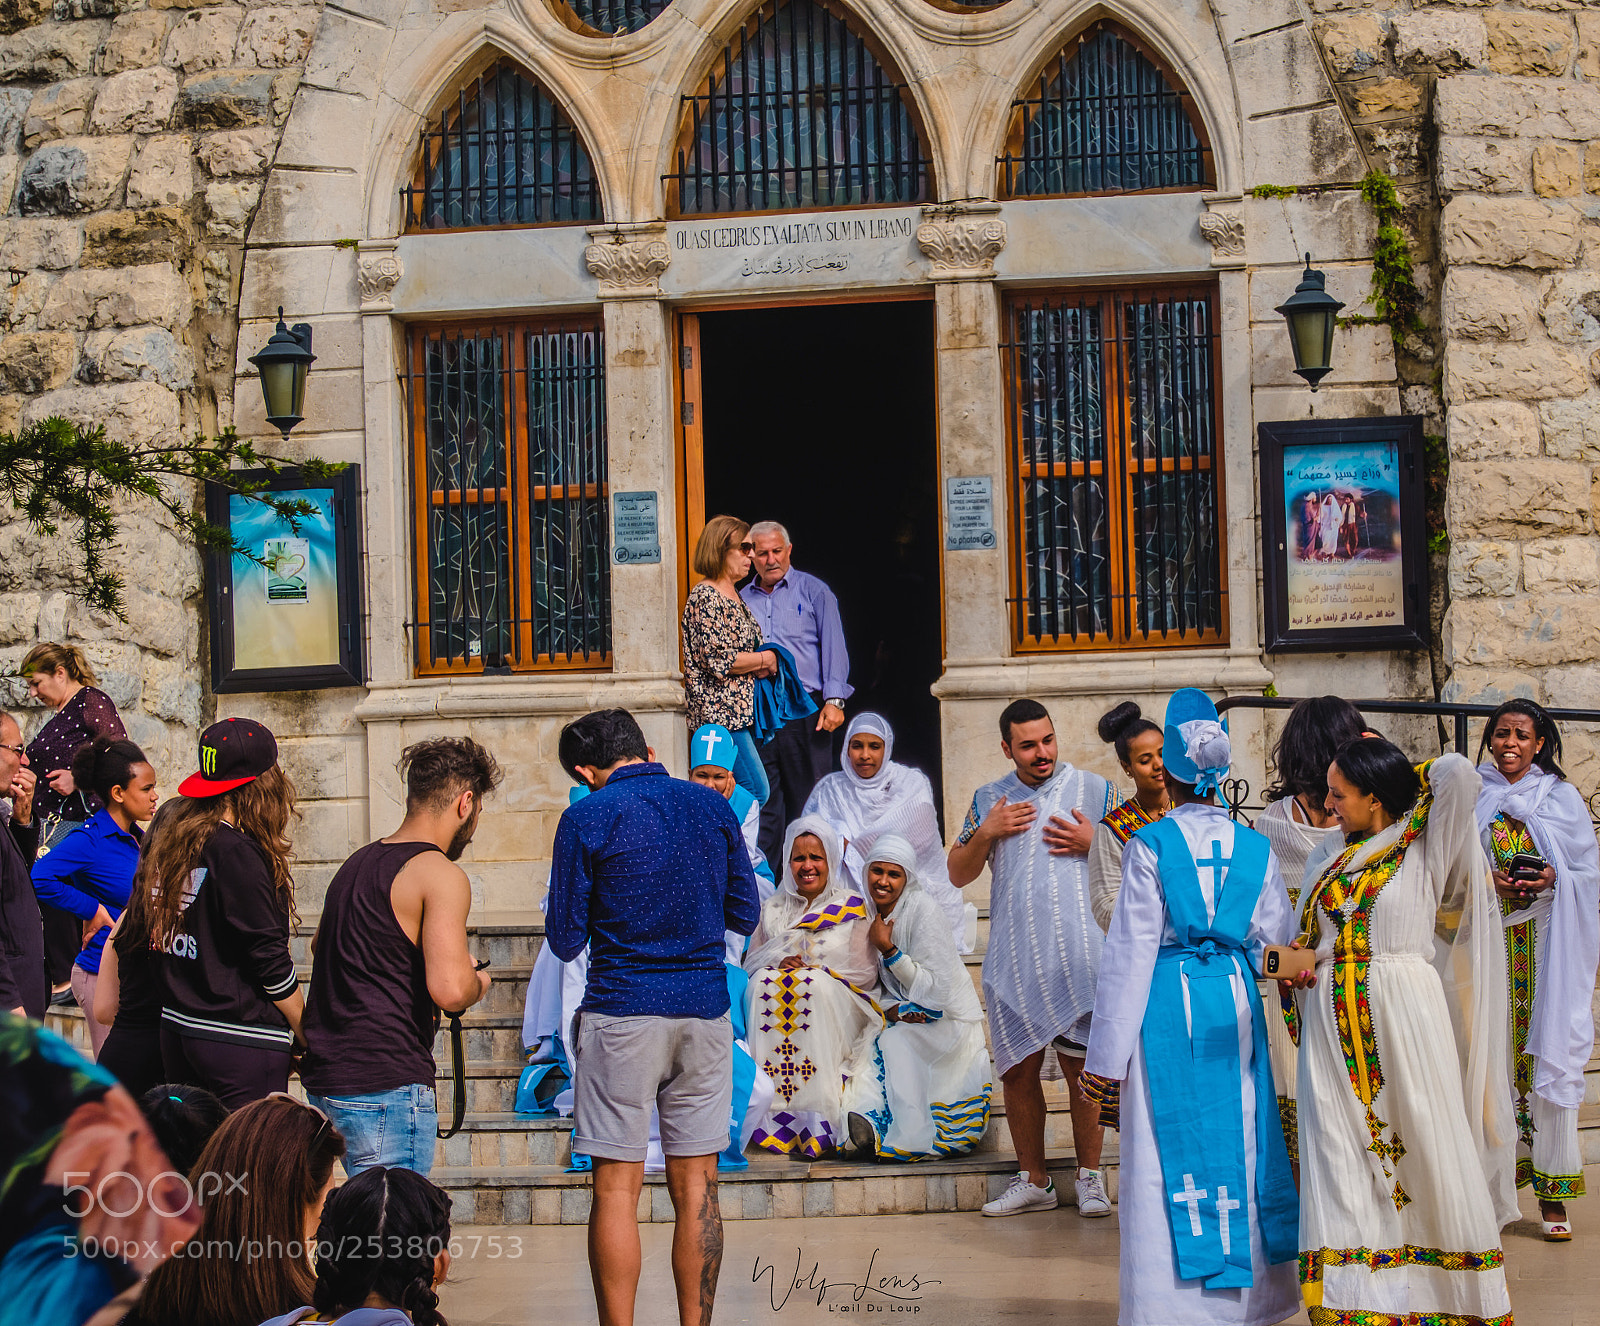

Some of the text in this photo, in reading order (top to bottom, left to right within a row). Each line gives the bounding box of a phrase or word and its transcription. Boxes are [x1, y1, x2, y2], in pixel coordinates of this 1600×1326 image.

[713, 226, 761, 248] CEDRUS
[763, 223, 822, 246] EXALTATA
[826, 220, 851, 242] SUM
[854, 220, 866, 240] IN
[870, 217, 911, 239] LIBANO
[948, 535, 980, 546] No photos
[630, 549, 653, 560] تصوير
